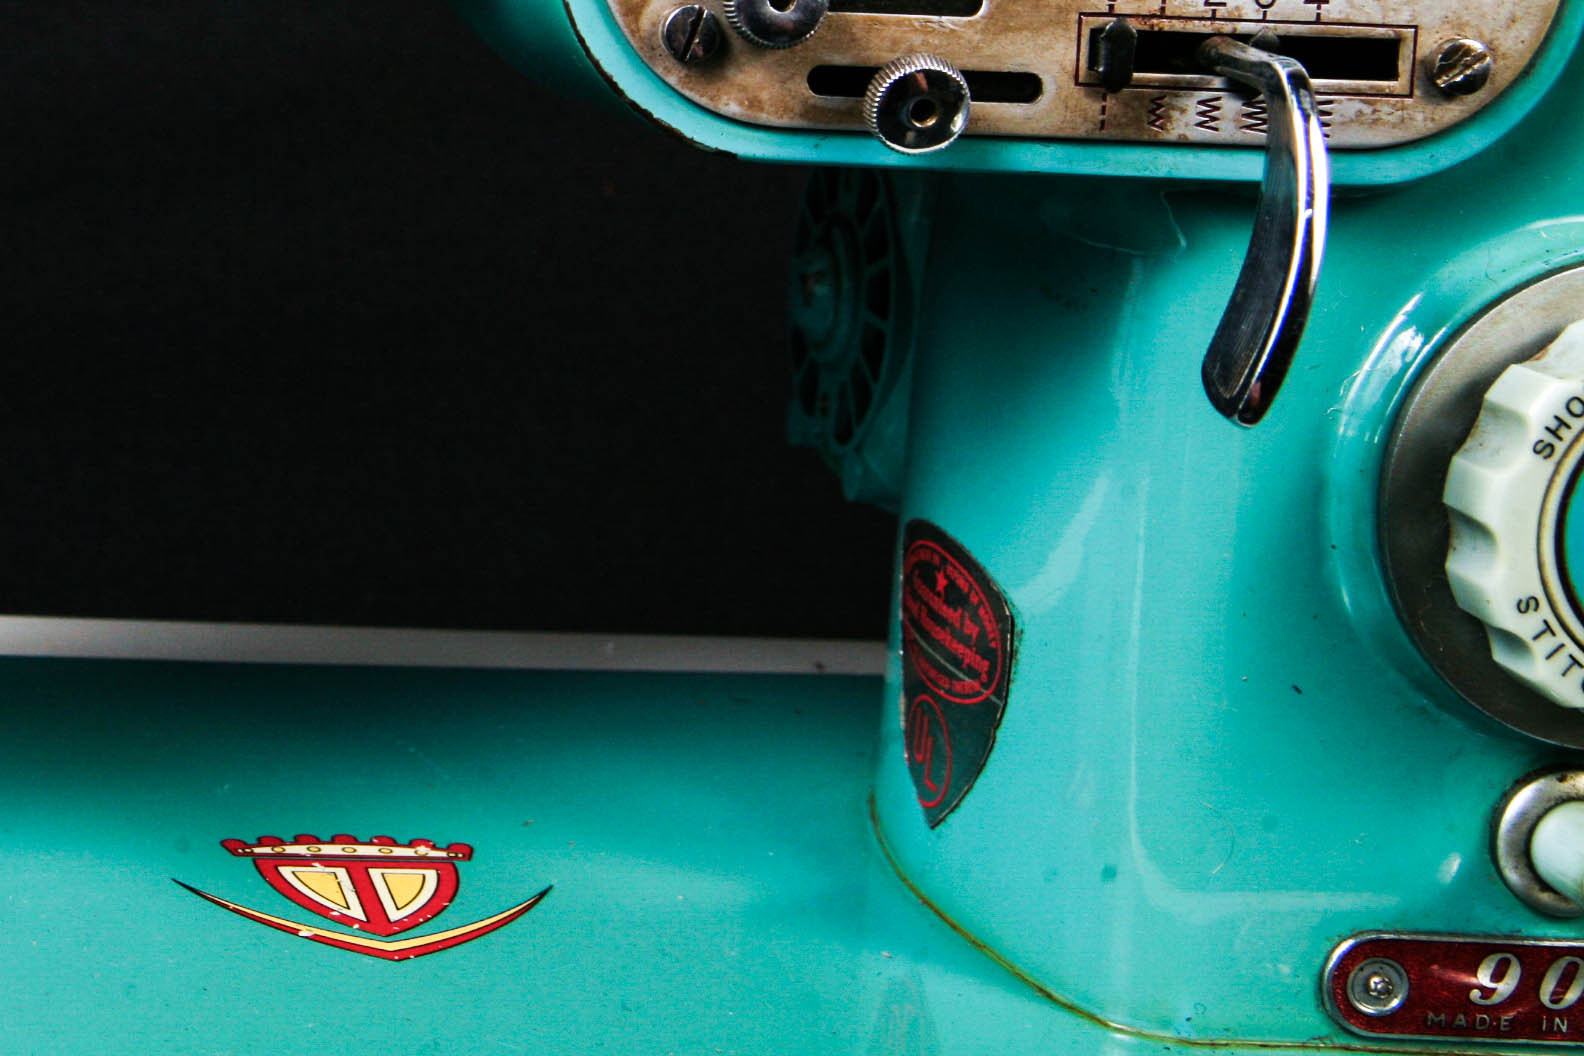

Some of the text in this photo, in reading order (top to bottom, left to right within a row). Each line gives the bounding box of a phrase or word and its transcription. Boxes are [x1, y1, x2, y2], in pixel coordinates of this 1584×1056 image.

[1516, 595, 1584, 694] STIT
[1428, 1013, 1569, 1034] MADE IN
